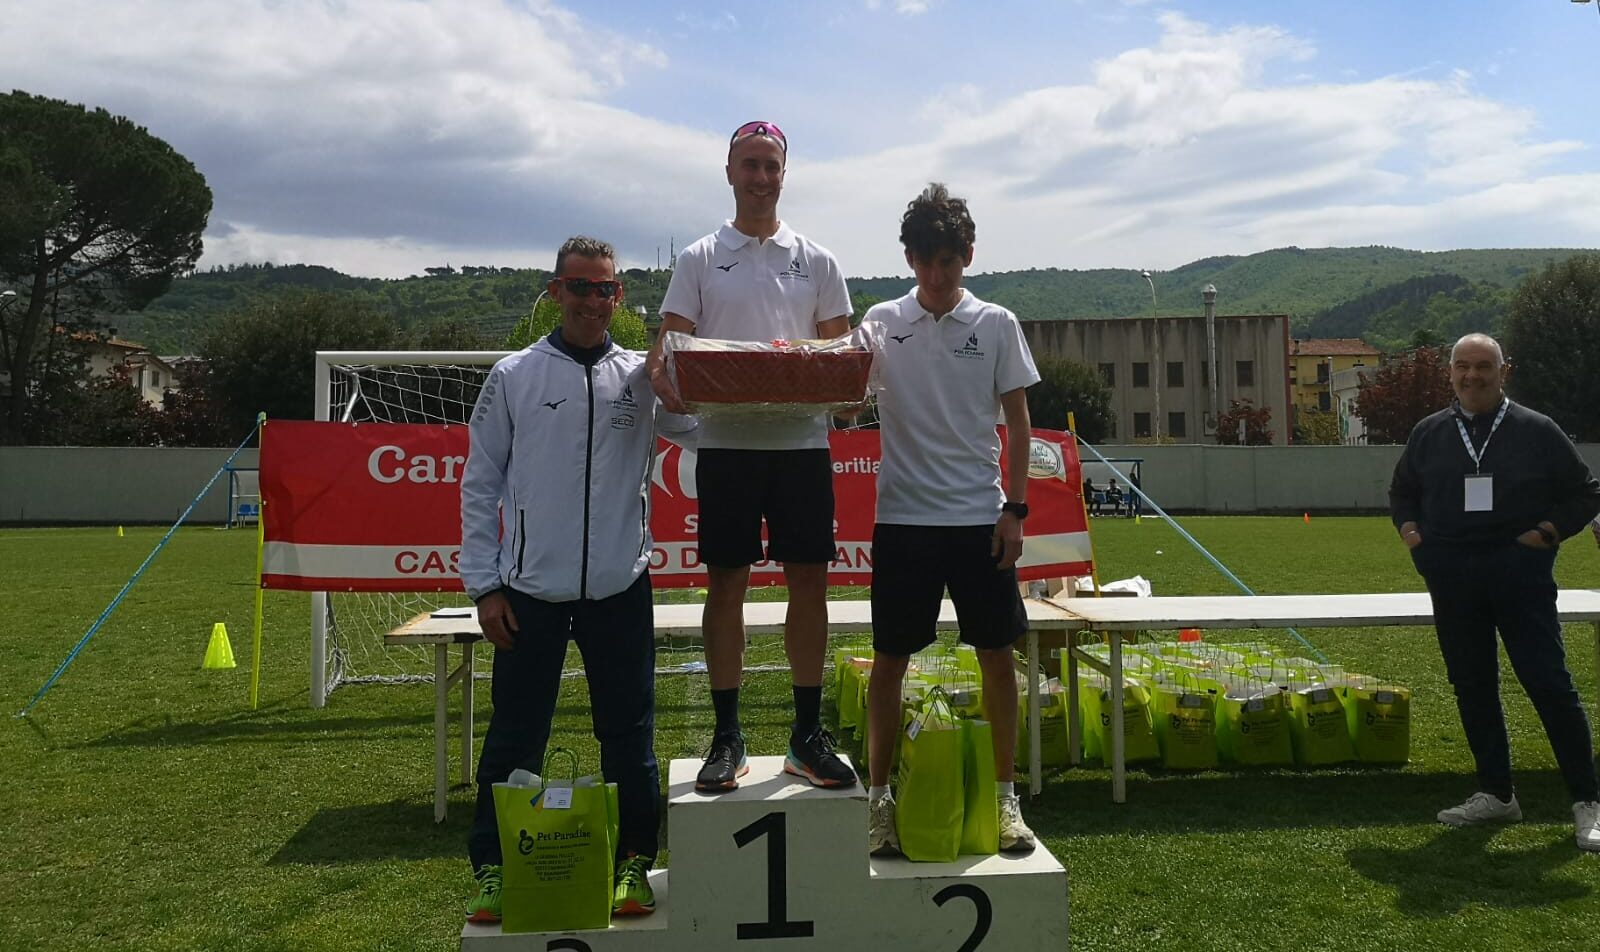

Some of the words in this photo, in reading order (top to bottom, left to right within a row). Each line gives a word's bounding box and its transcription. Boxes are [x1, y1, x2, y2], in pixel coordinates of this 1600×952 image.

[537, 832, 552, 841] Pet
[554, 829, 592, 841] Paradise
[732, 811, 814, 940] 1
[931, 882, 993, 952] 2
